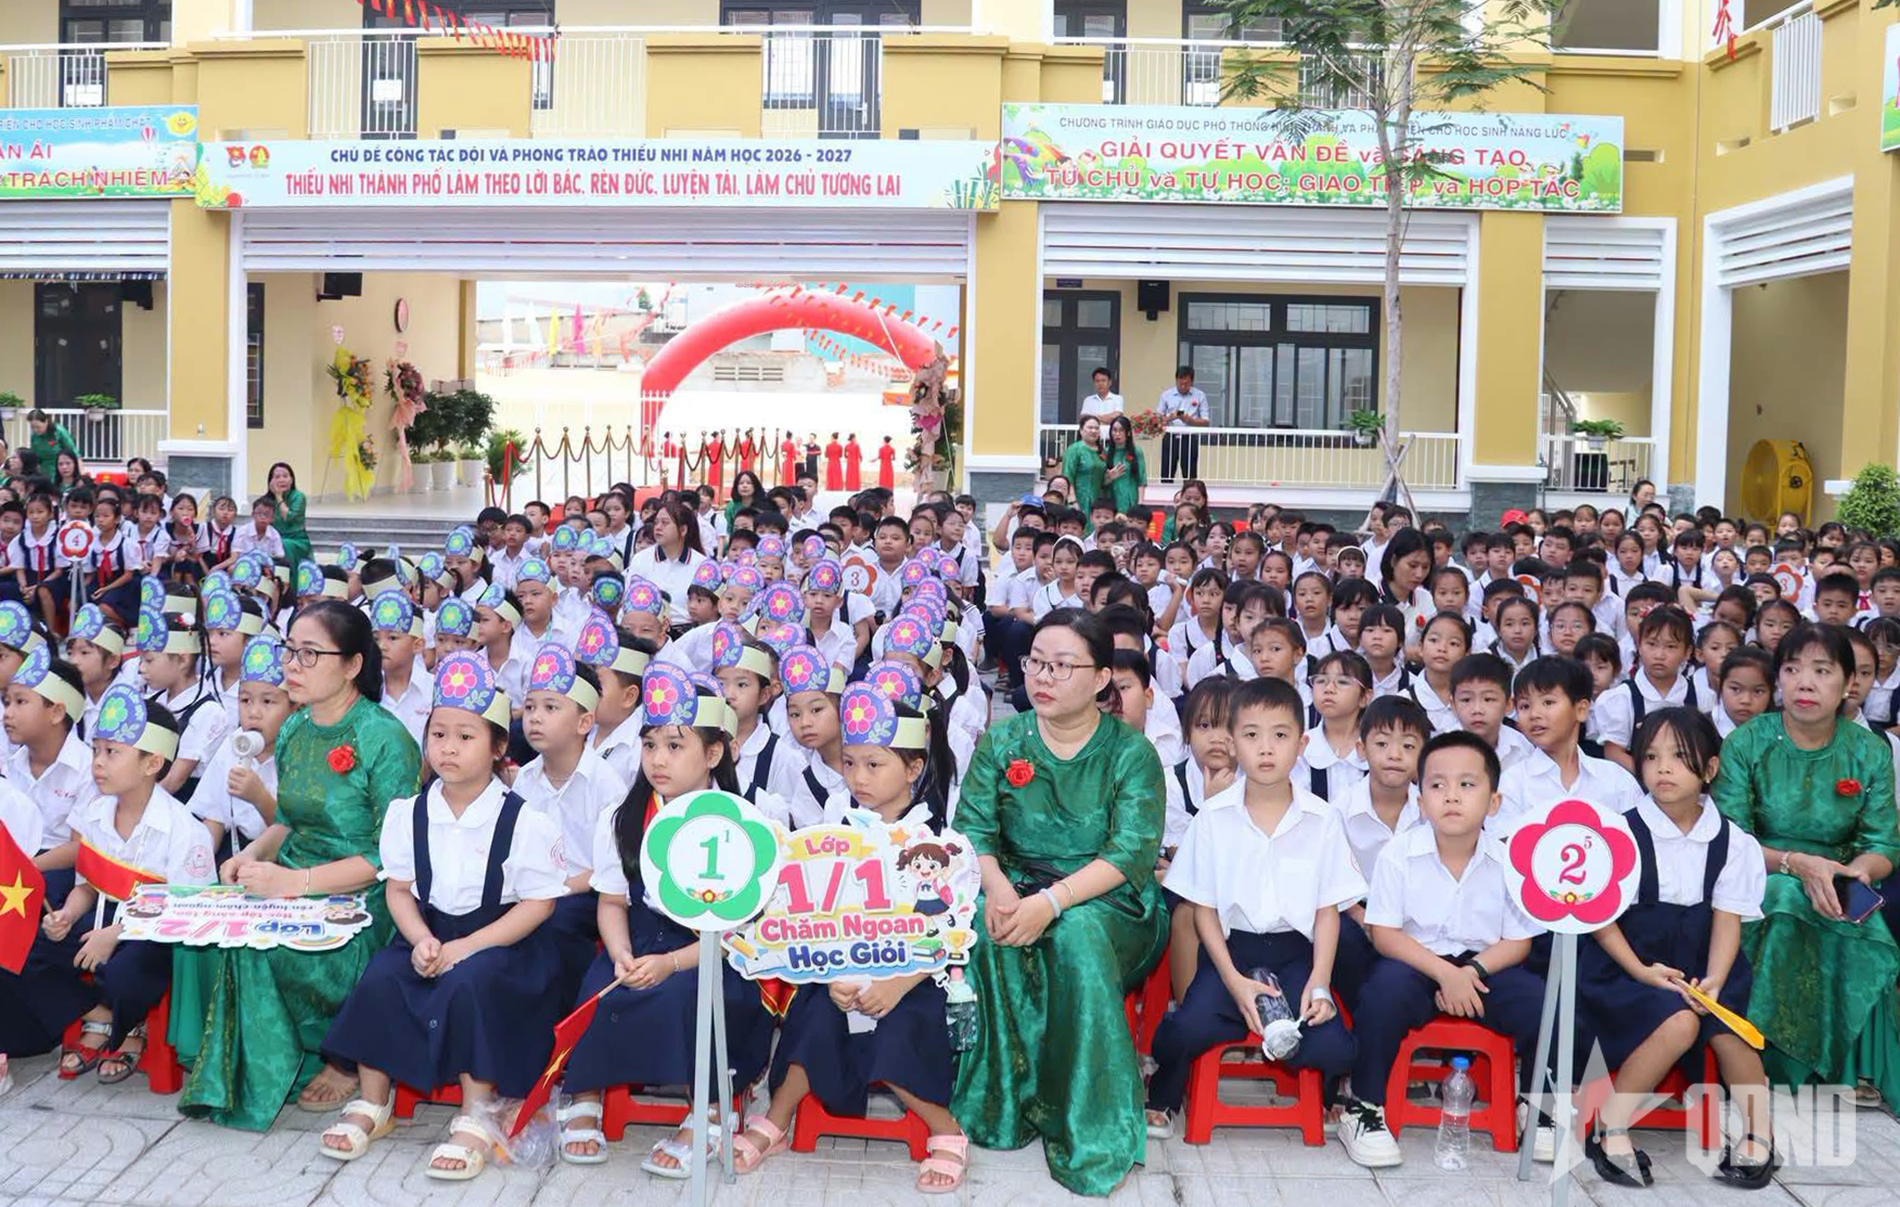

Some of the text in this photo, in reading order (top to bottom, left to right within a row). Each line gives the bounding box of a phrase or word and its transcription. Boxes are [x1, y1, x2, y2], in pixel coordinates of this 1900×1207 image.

[23, 119, 43, 130] CHO
[70, 118, 90, 129] SINH
[1060, 117, 1107, 129] CHƯƠNG
[1111, 116, 1143, 129] TRÌNH
[1146, 116, 1173, 130] GIÁO
[1177, 119, 1200, 132] DỤC
[1481, 126, 1507, 137] SINH
[331, 146, 358, 162] CHỦ
[364, 145, 381, 162] ĐỀ
[386, 147, 424, 162] CÔNG
[428, 145, 455, 162] TÁC
[459, 147, 484, 166] ĐỘI
[488, 146, 509, 162] VÀ
[513, 148, 563, 162] PHONG
[568, 145, 608, 162] TRÀO
[613, 143, 656, 162] THIẾU
[661, 148, 687, 162] NHI
[692, 146, 726, 162] NĂM
[731, 148, 761, 165] HỌC
[766, 149, 802, 162] 2026
[816, 149, 852, 162] 2027
[1100, 135, 1151, 159] GIẢI
[1160, 137, 1246, 160] QUYẾT
[1256, 139, 1305, 161] VẤN
[1316, 139, 1348, 163] ĐỀ
[1475, 149, 1526, 169] TẠO
[8, 169, 85, 187] TRÁCH
[285, 166, 323, 195] THIẾU
[329, 173, 353, 195] NHI
[359, 169, 407, 195] THÀNH
[412, 167, 442, 195] PHỐ
[446, 169, 478, 195] LÀM
[485, 173, 520, 195] THEO
[526, 168, 548, 195] LỜI
[591, 169, 619, 195] RÈN
[663, 168, 709, 200] LUYỆN
[746, 170, 779, 196] LÀM
[785, 168, 815, 195] CHỦ
[822, 172, 871, 196] TƯƠNG
[877, 174, 900, 196] LAI
[1044, 168, 1078, 190] TỰ
[1087, 164, 1140, 188] CHỦ
[1150, 170, 1176, 189] và
[1186, 172, 1220, 193] TỰ
[1299, 174, 1360, 193] GIAO
[1468, 177, 1519, 198] HỢP
[1530, 177, 1579, 198] TÁC
[851, 571, 860, 587] 3
[805, 835, 850, 857] Lớp
[777, 859, 891, 915] 1/1
[158, 919, 323, 939] Lớp 1/2
[761, 915, 924, 941] Chăm Ngoan
[788, 939, 906, 972] Học Giỏi
